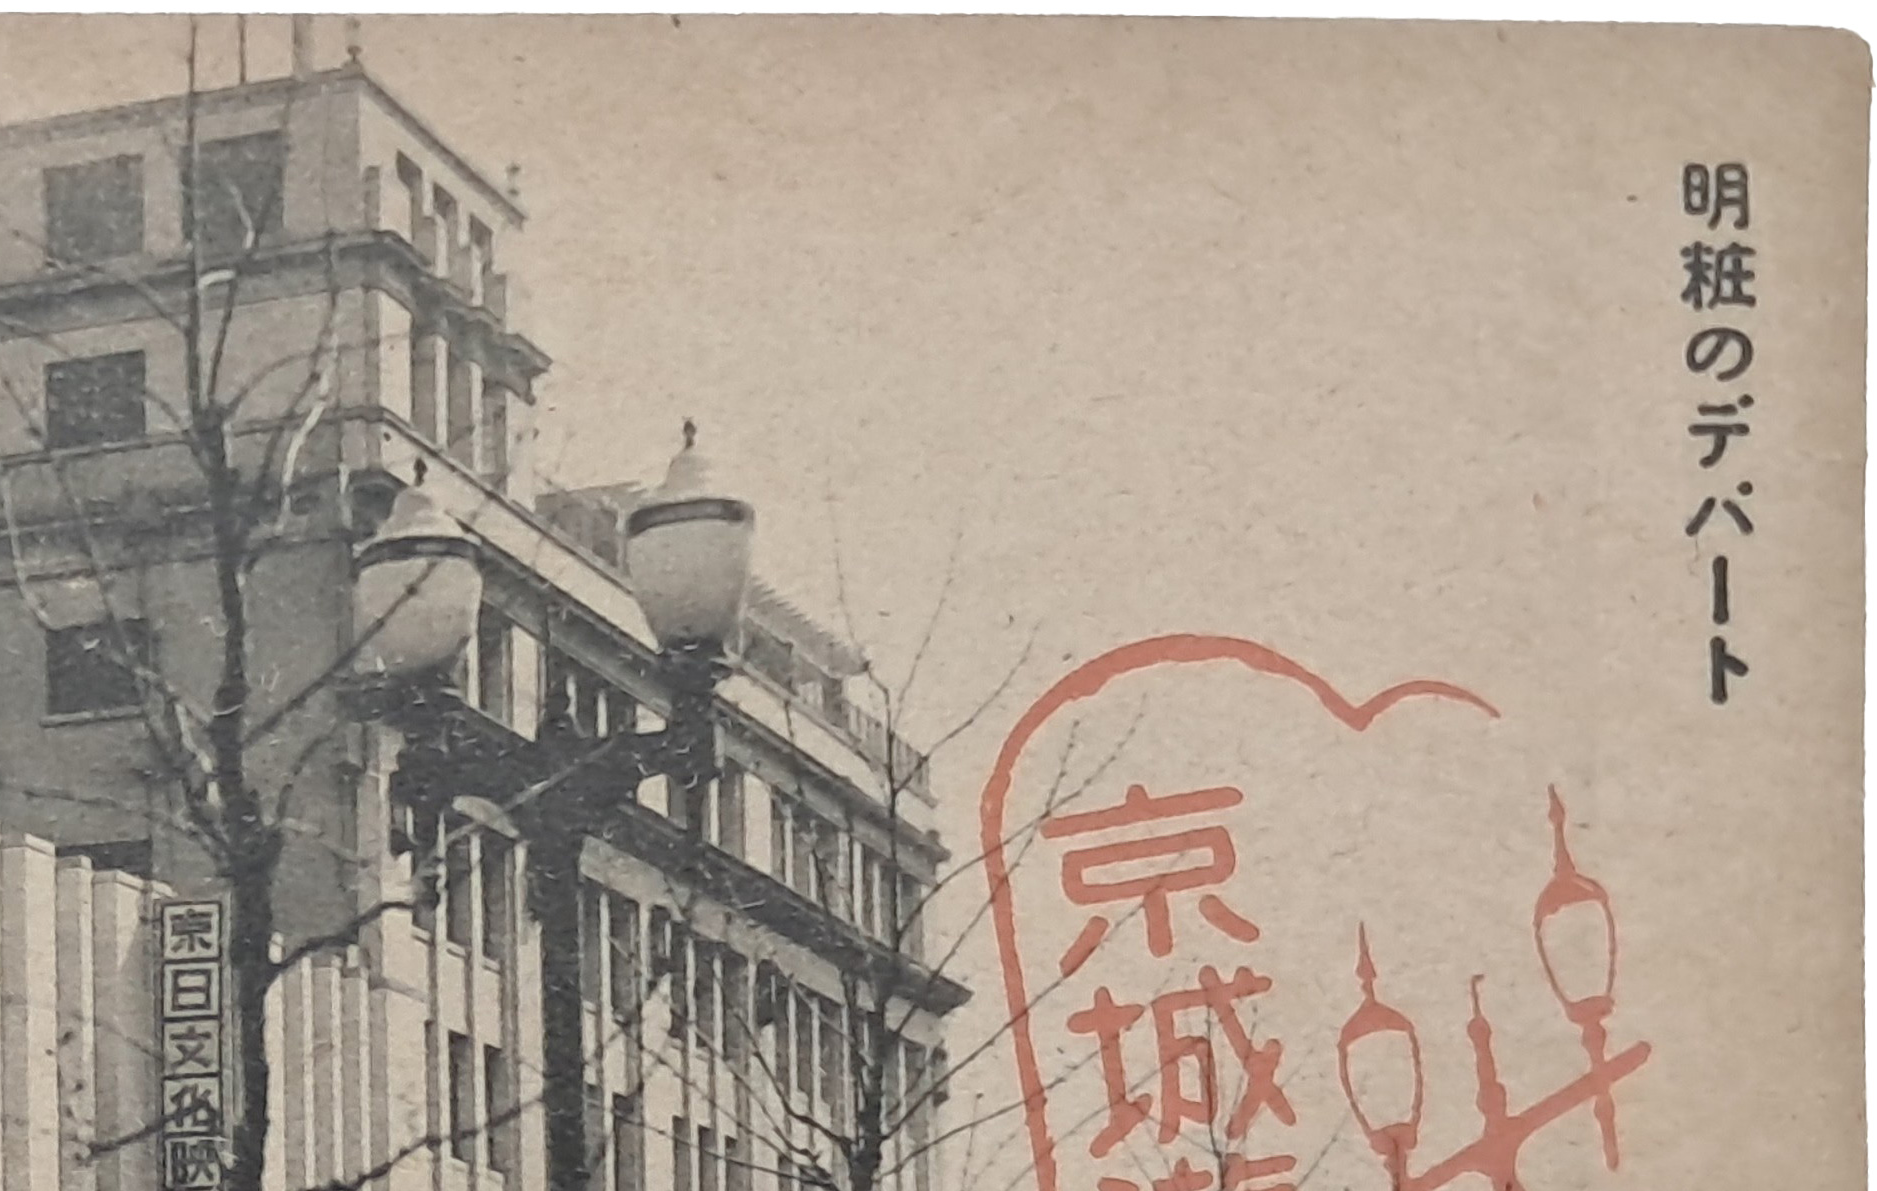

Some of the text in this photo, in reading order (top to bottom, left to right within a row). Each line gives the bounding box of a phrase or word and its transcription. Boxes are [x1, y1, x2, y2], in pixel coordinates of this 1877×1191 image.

[1680, 162, 1757, 705] 明粧のデパート
